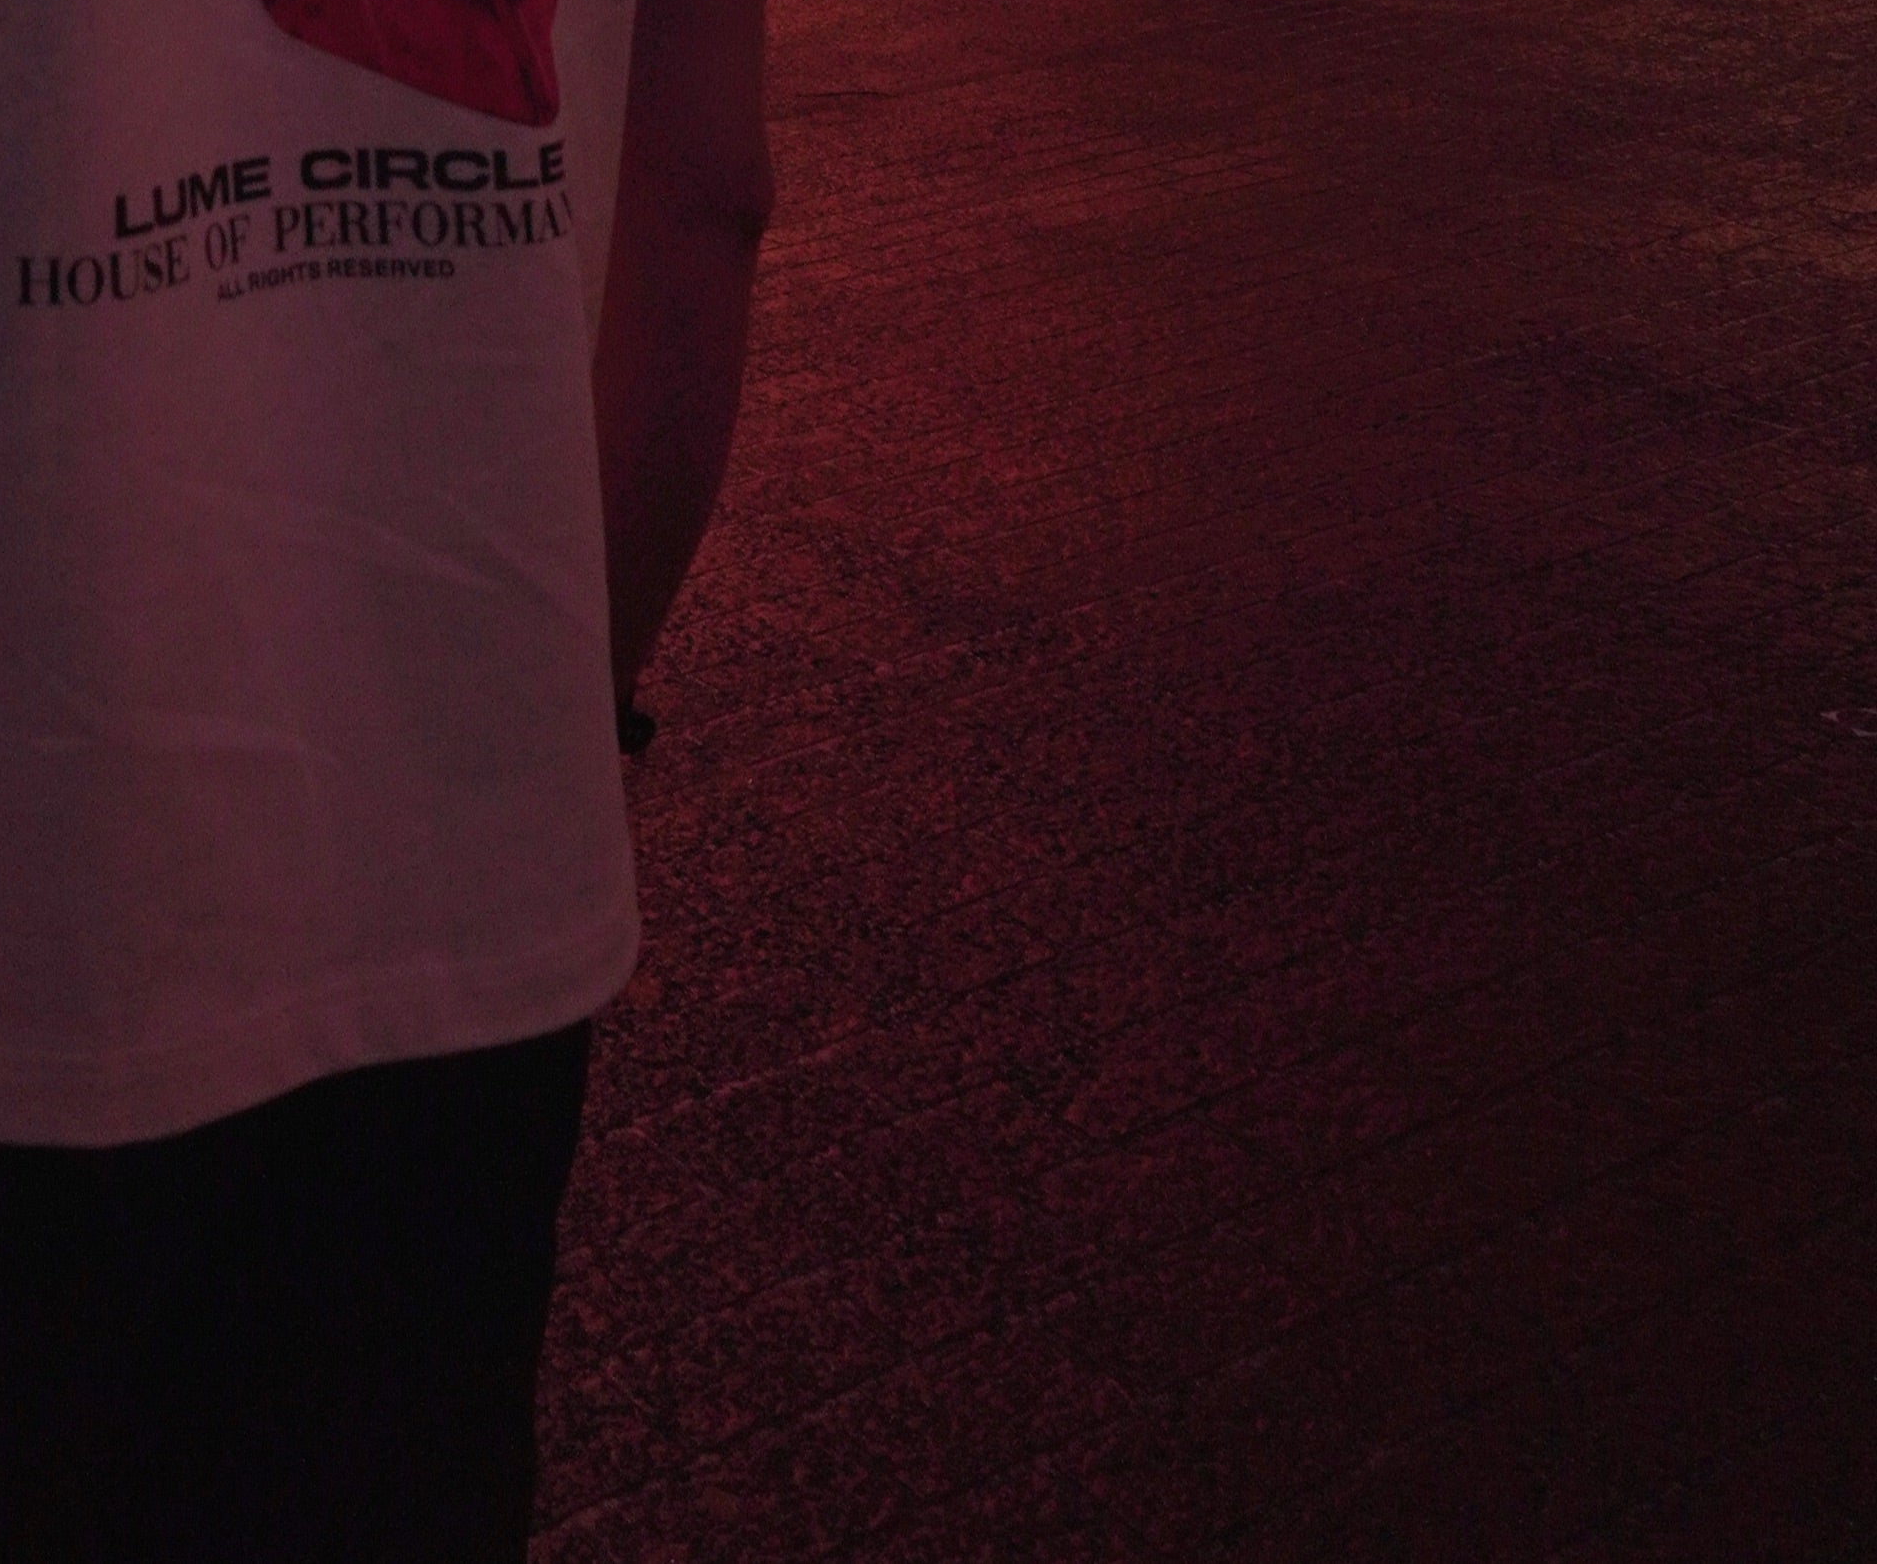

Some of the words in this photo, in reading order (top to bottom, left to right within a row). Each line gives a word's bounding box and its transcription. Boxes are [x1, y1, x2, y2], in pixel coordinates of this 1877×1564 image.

[114, 156, 272, 239] LUME
[300, 141, 567, 192] CIRCLE
[16, 236, 192, 308] HOUSE
[204, 214, 251, 272] OF
[216, 275, 246, 301] ALL
[247, 260, 323, 295] RIGHTS
[327, 257, 455, 281] RESERVED
